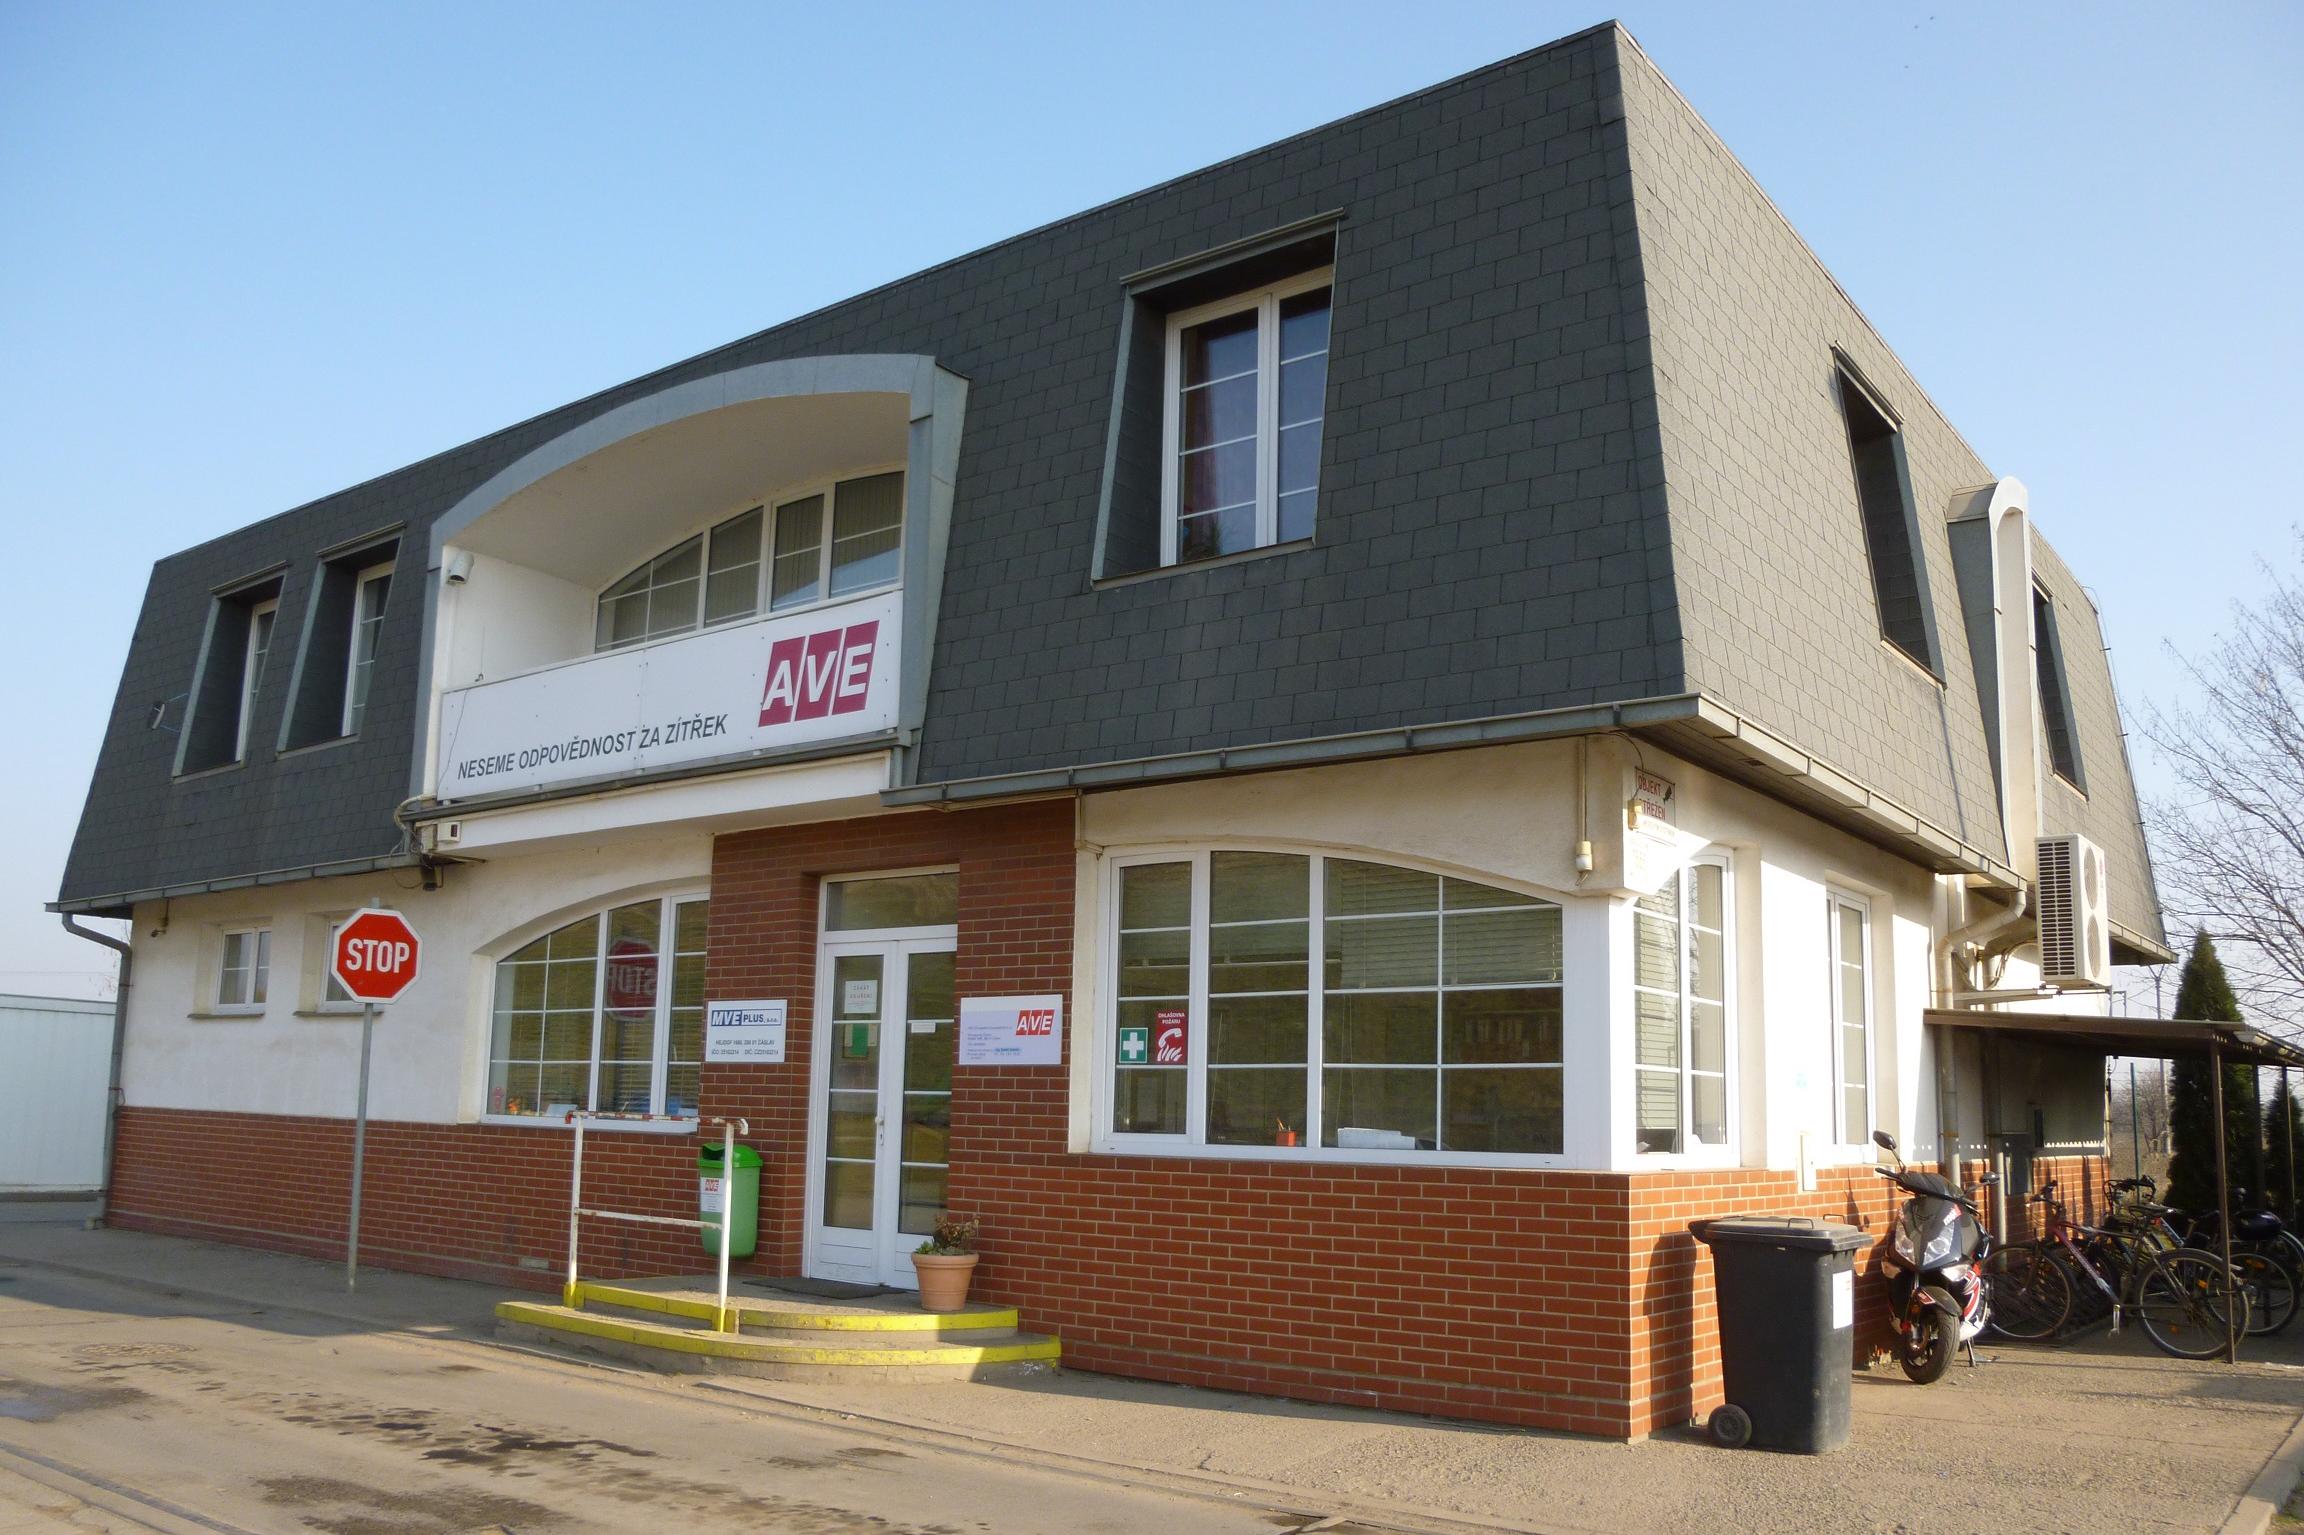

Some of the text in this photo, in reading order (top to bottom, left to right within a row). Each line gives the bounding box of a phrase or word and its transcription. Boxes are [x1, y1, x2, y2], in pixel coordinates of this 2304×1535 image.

[761, 643, 873, 711] AVE
[457, 713, 728, 780] NESEME ODPOVĚDNOST ZA ZÍTŘEK
[1637, 775, 1662, 797] OBJEKT
[346, 938, 410, 974] STOP
[712, 1010, 741, 1026] MVE
[1017, 1015, 1053, 1031] AVE
